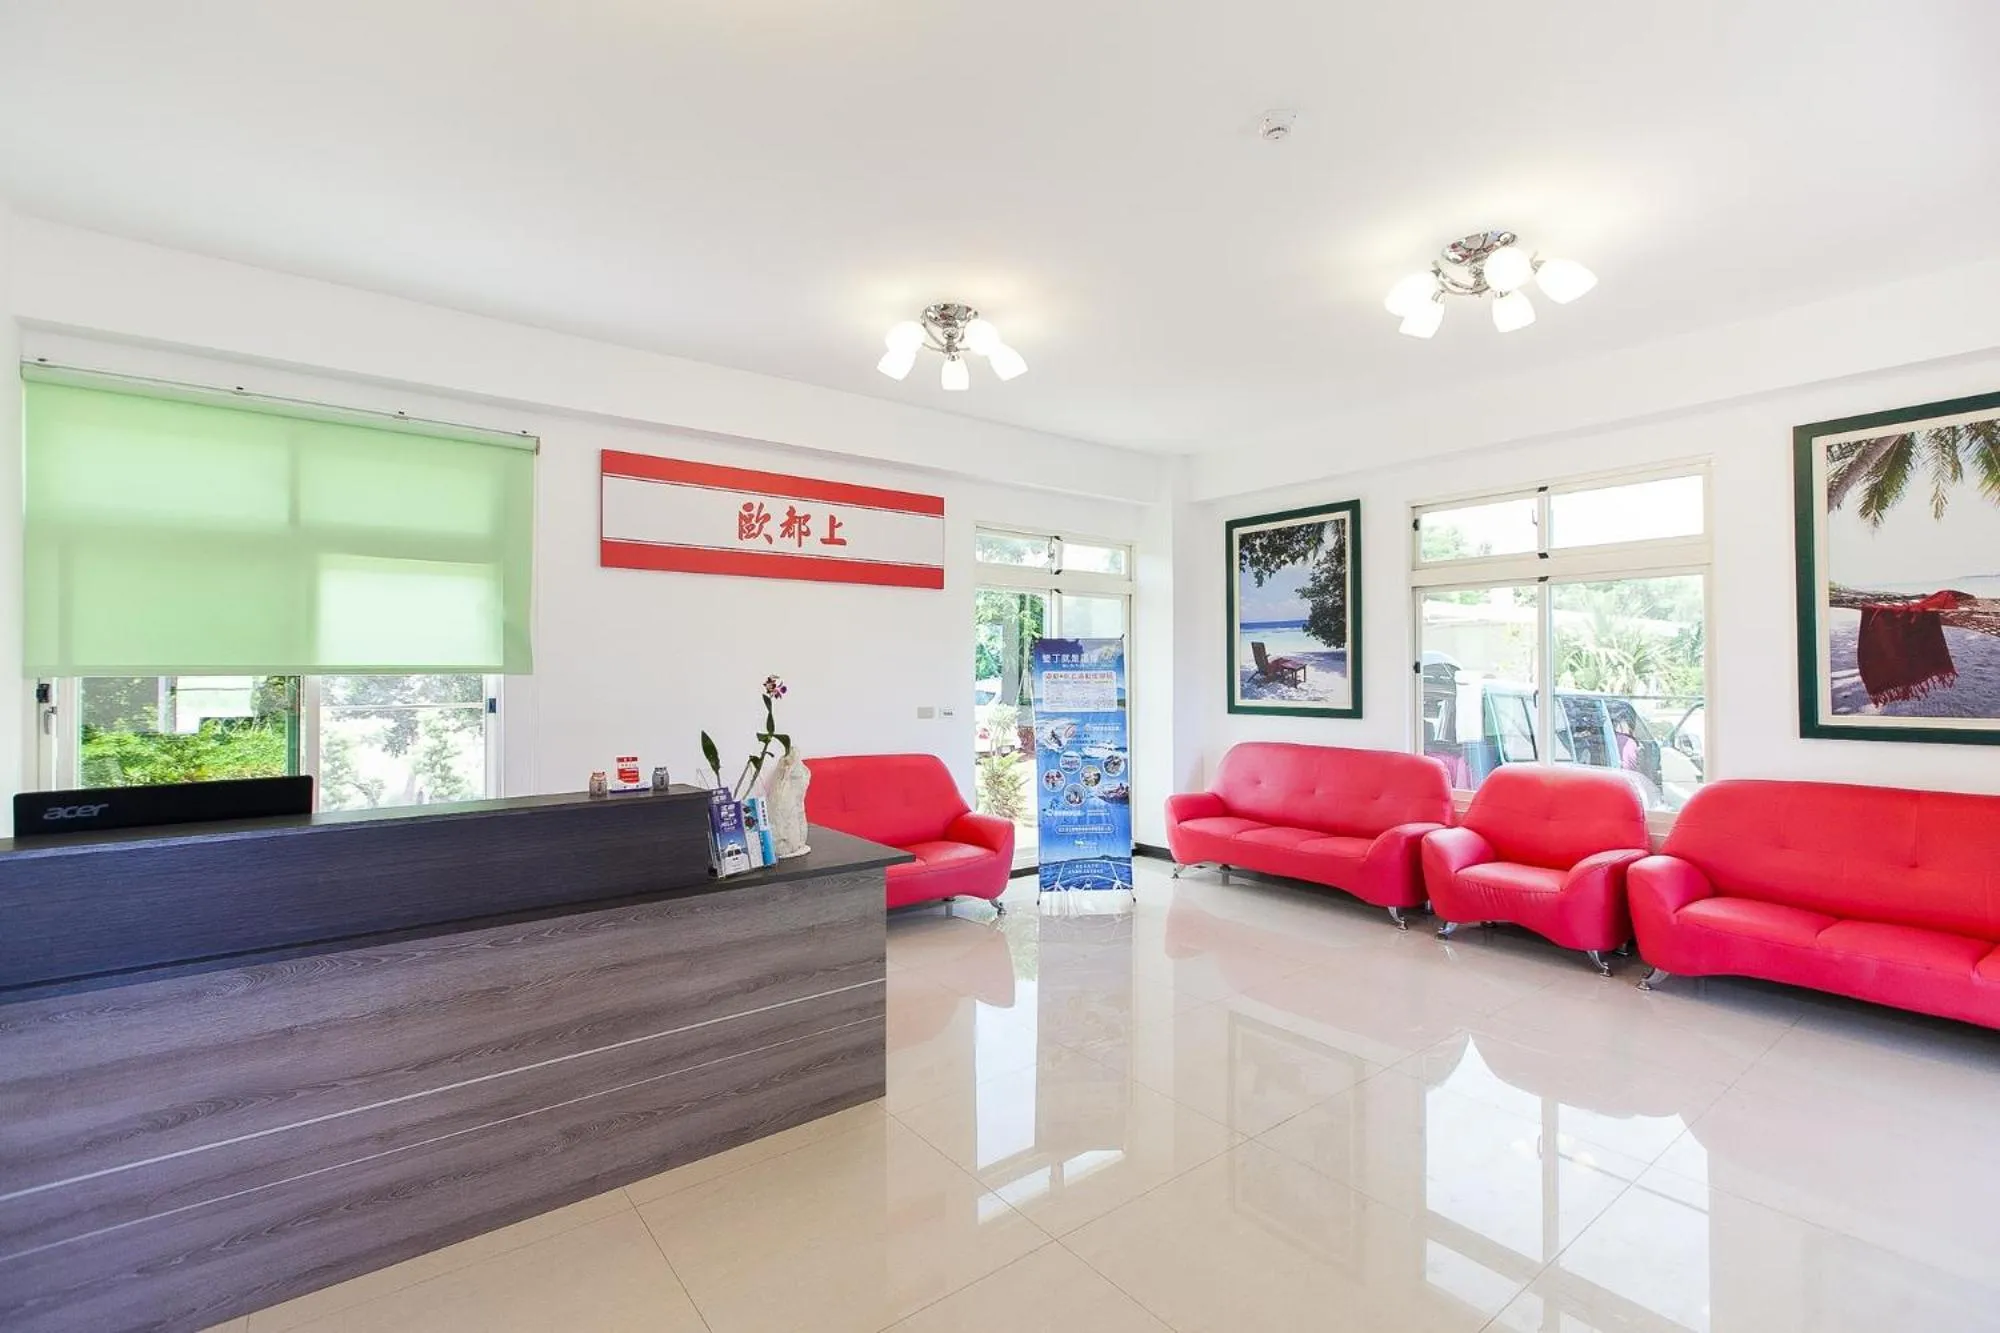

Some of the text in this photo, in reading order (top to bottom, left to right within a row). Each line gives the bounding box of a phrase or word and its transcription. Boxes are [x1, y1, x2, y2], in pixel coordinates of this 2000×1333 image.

[738, 502, 847, 548] 歐都上
[42, 803, 109, 820] acer
